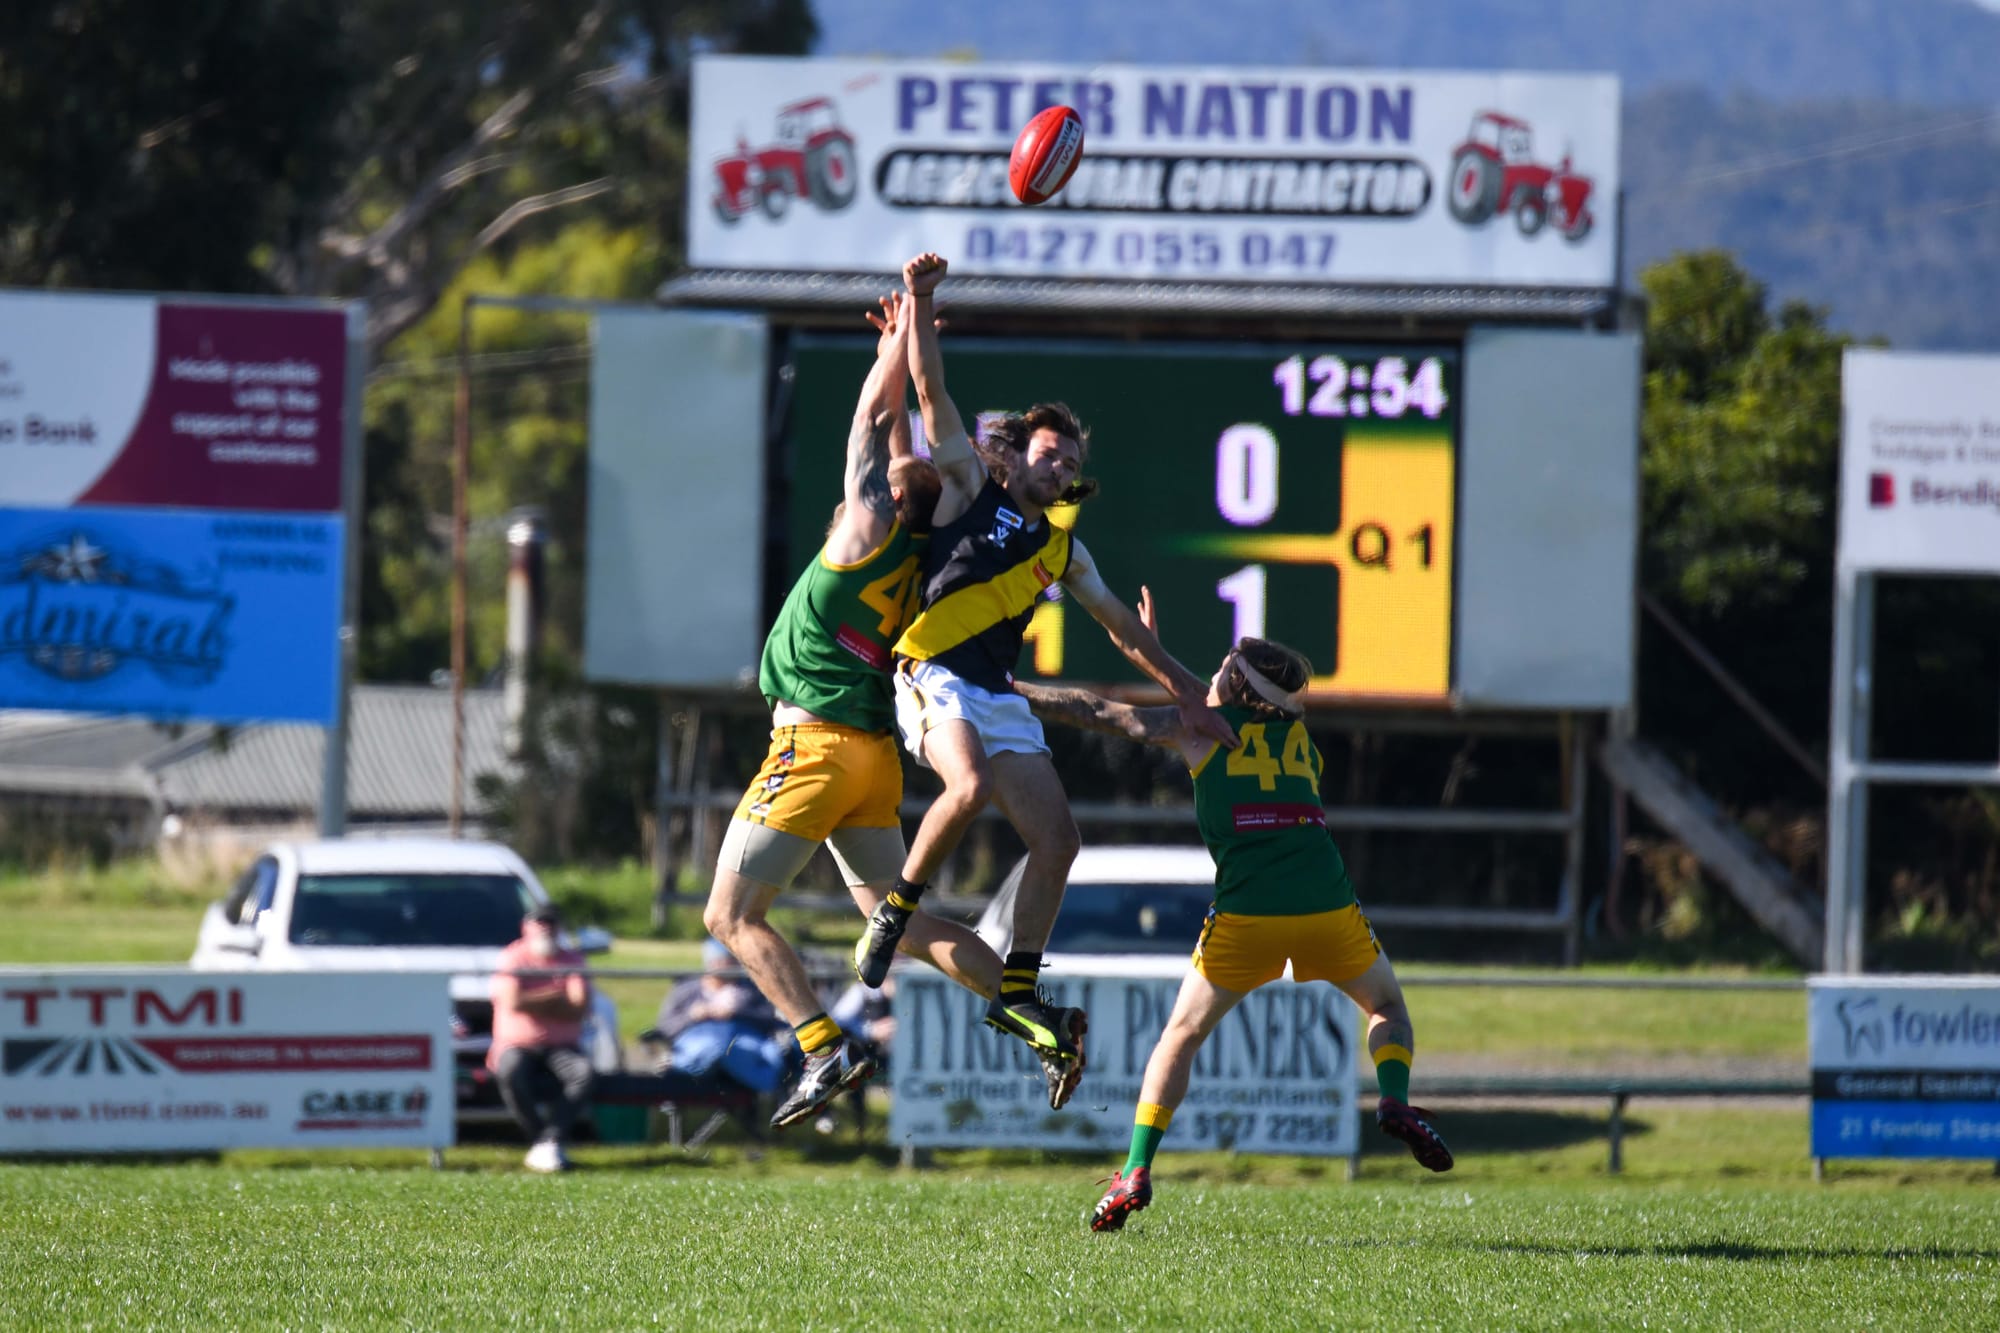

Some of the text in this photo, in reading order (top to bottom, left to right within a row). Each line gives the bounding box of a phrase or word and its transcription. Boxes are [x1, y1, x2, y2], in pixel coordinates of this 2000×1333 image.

[898, 77, 1412, 142] PETER NATION
[884, 154, 1427, 212] AGRICURAL CONTRACTOR
[965, 226, 1336, 268] 0427 055 047
[1272, 354, 1448, 418] 12:54
[24, 414, 97, 446] Bank
[1215, 422, 1280, 527] 0
[1350, 521, 1435, 571] Q 1
[1217, 564, 1268, 648] 1
[1226, 719, 1320, 798] 44
[2, 986, 245, 1028] TTMI
[301, 1088, 395, 1116] CASE
